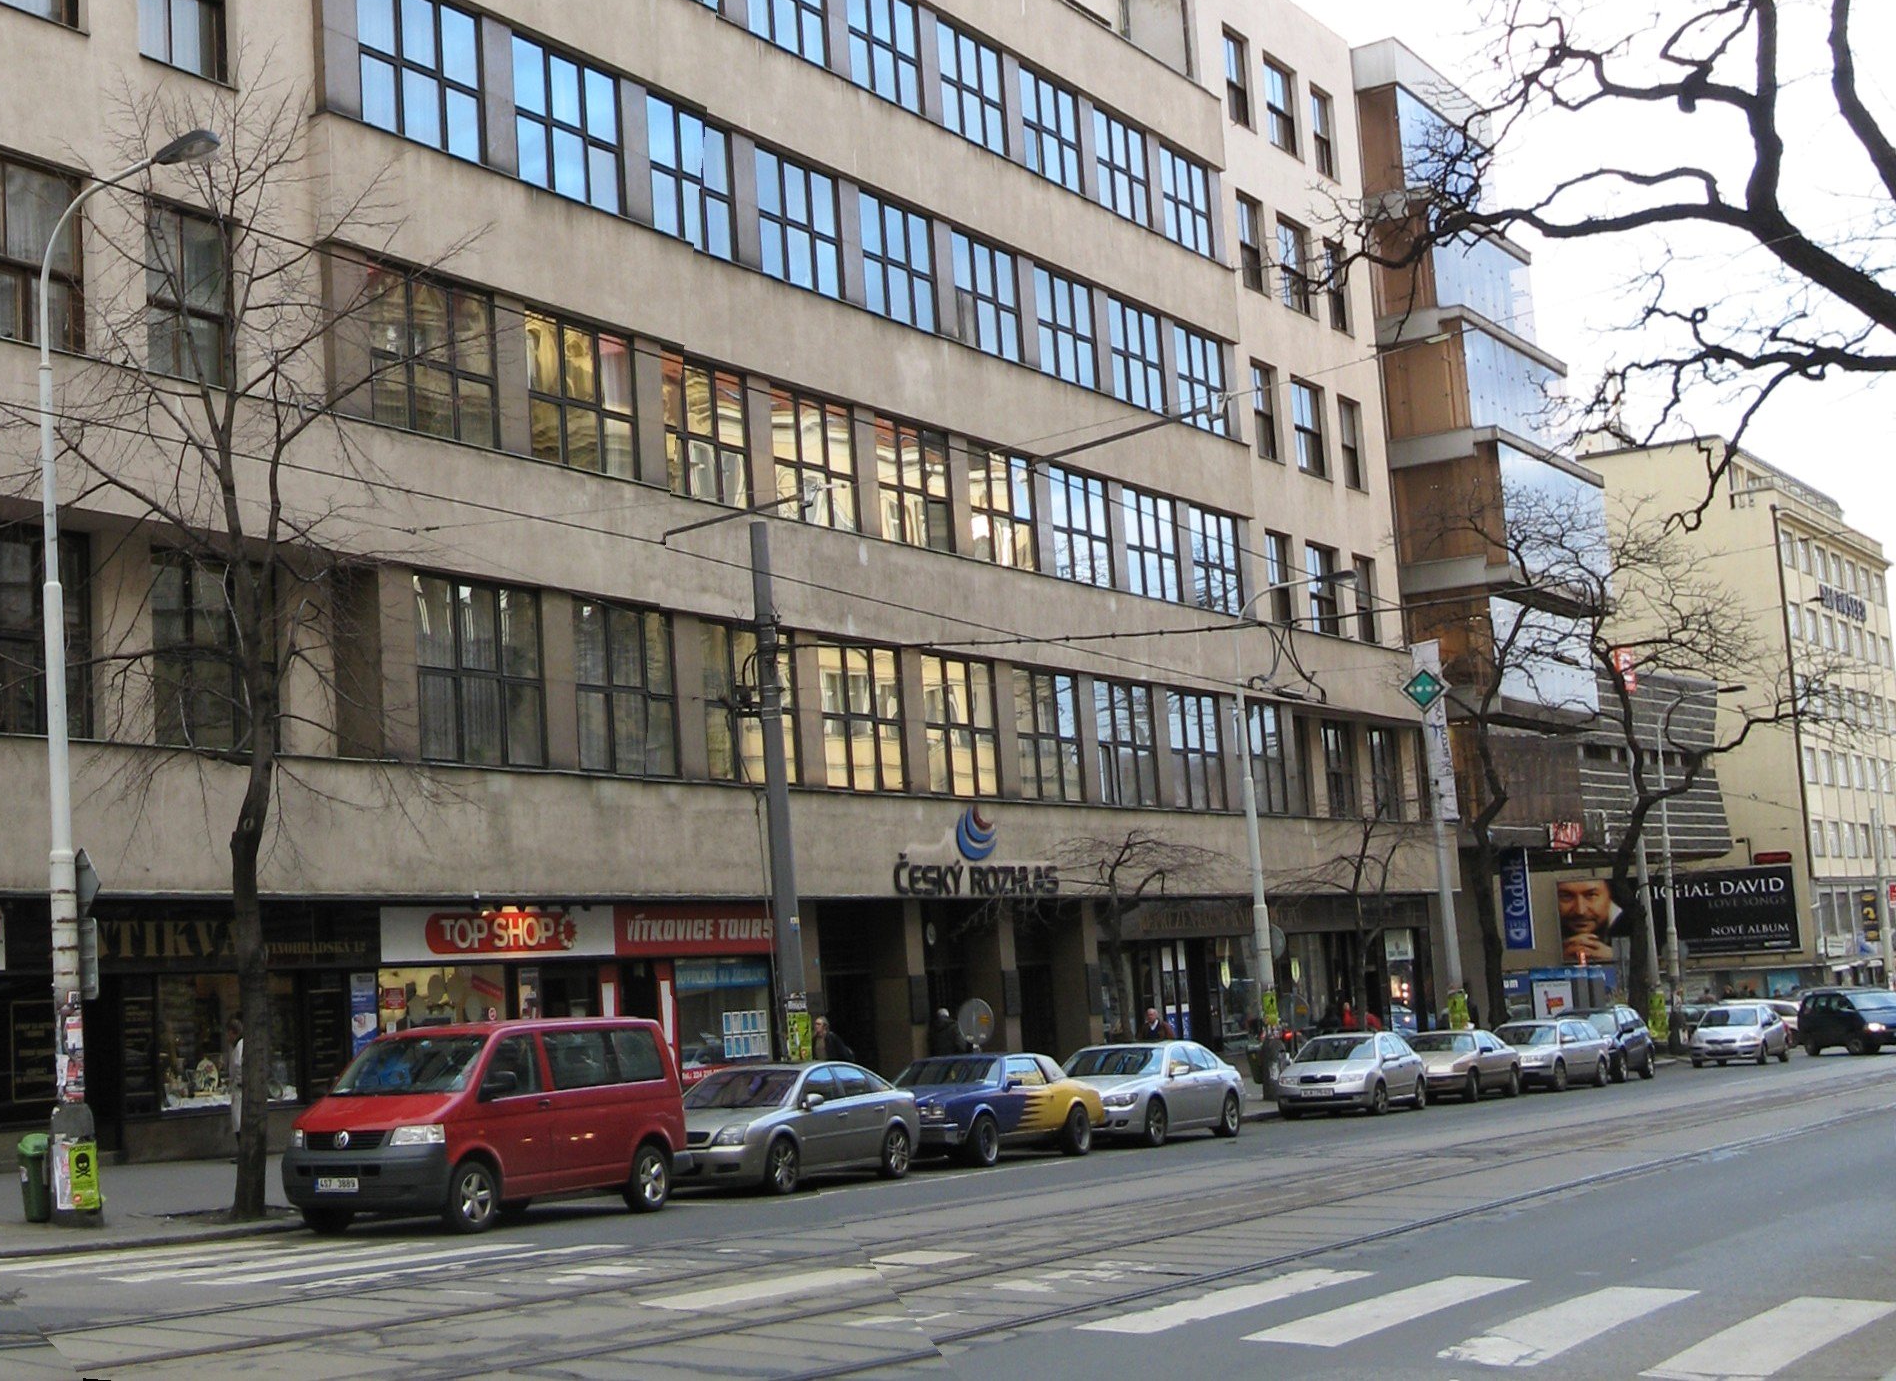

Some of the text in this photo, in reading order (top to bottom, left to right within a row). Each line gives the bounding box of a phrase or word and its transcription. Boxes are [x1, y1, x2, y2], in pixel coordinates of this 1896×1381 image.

[893, 851, 1060, 896] ČESKÝ ROZHLAS
[1720, 876, 1785, 896] DAVID
[1707, 894, 1787, 909] LOVE SONGS
[438, 916, 554, 949] TOP SHOP
[626, 913, 775, 942] VÍTKOVICE TOURS
[1710, 922, 1791, 937] NOVÉ ALBUM
